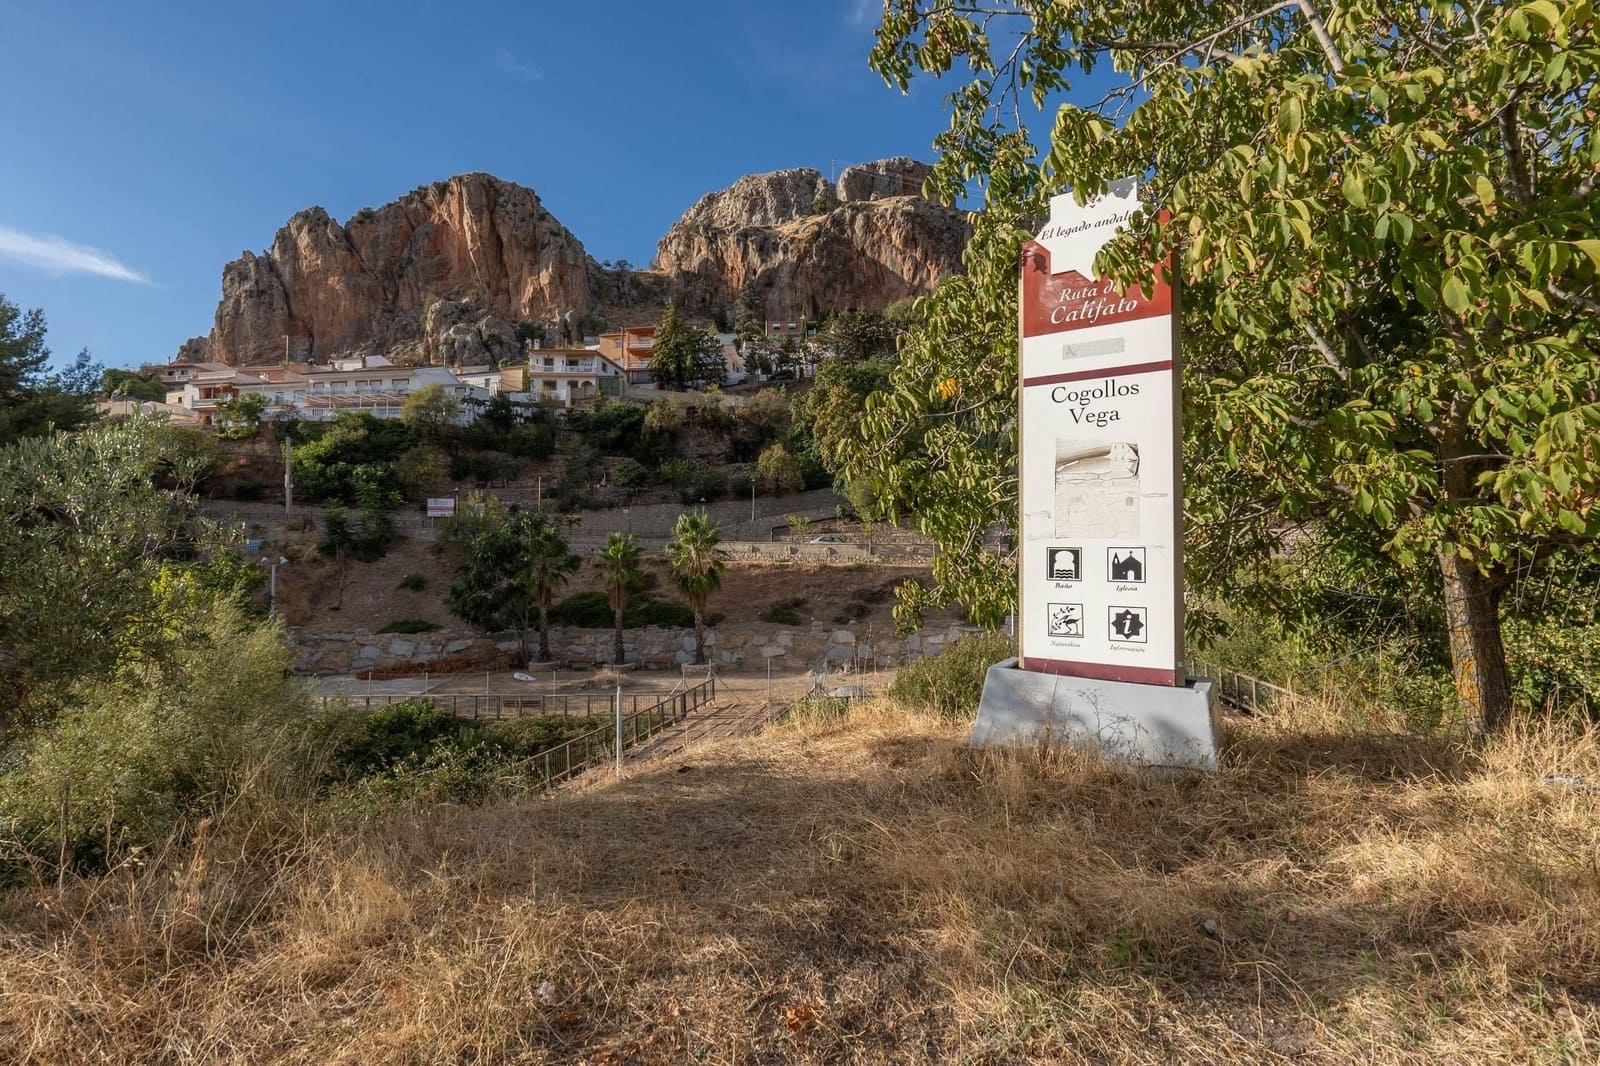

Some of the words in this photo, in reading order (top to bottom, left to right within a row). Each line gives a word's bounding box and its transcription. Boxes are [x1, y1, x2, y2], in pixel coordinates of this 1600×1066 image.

[1041, 226, 1054, 241] El
[1056, 220, 1092, 237] legado
[1094, 210, 1130, 228] andal
[1059, 285, 1098, 303] Ruta
[1050, 298, 1138, 324] Califato
[1051, 379, 1140, 406] Cogollos
[1069, 407, 1121, 428] Vega
